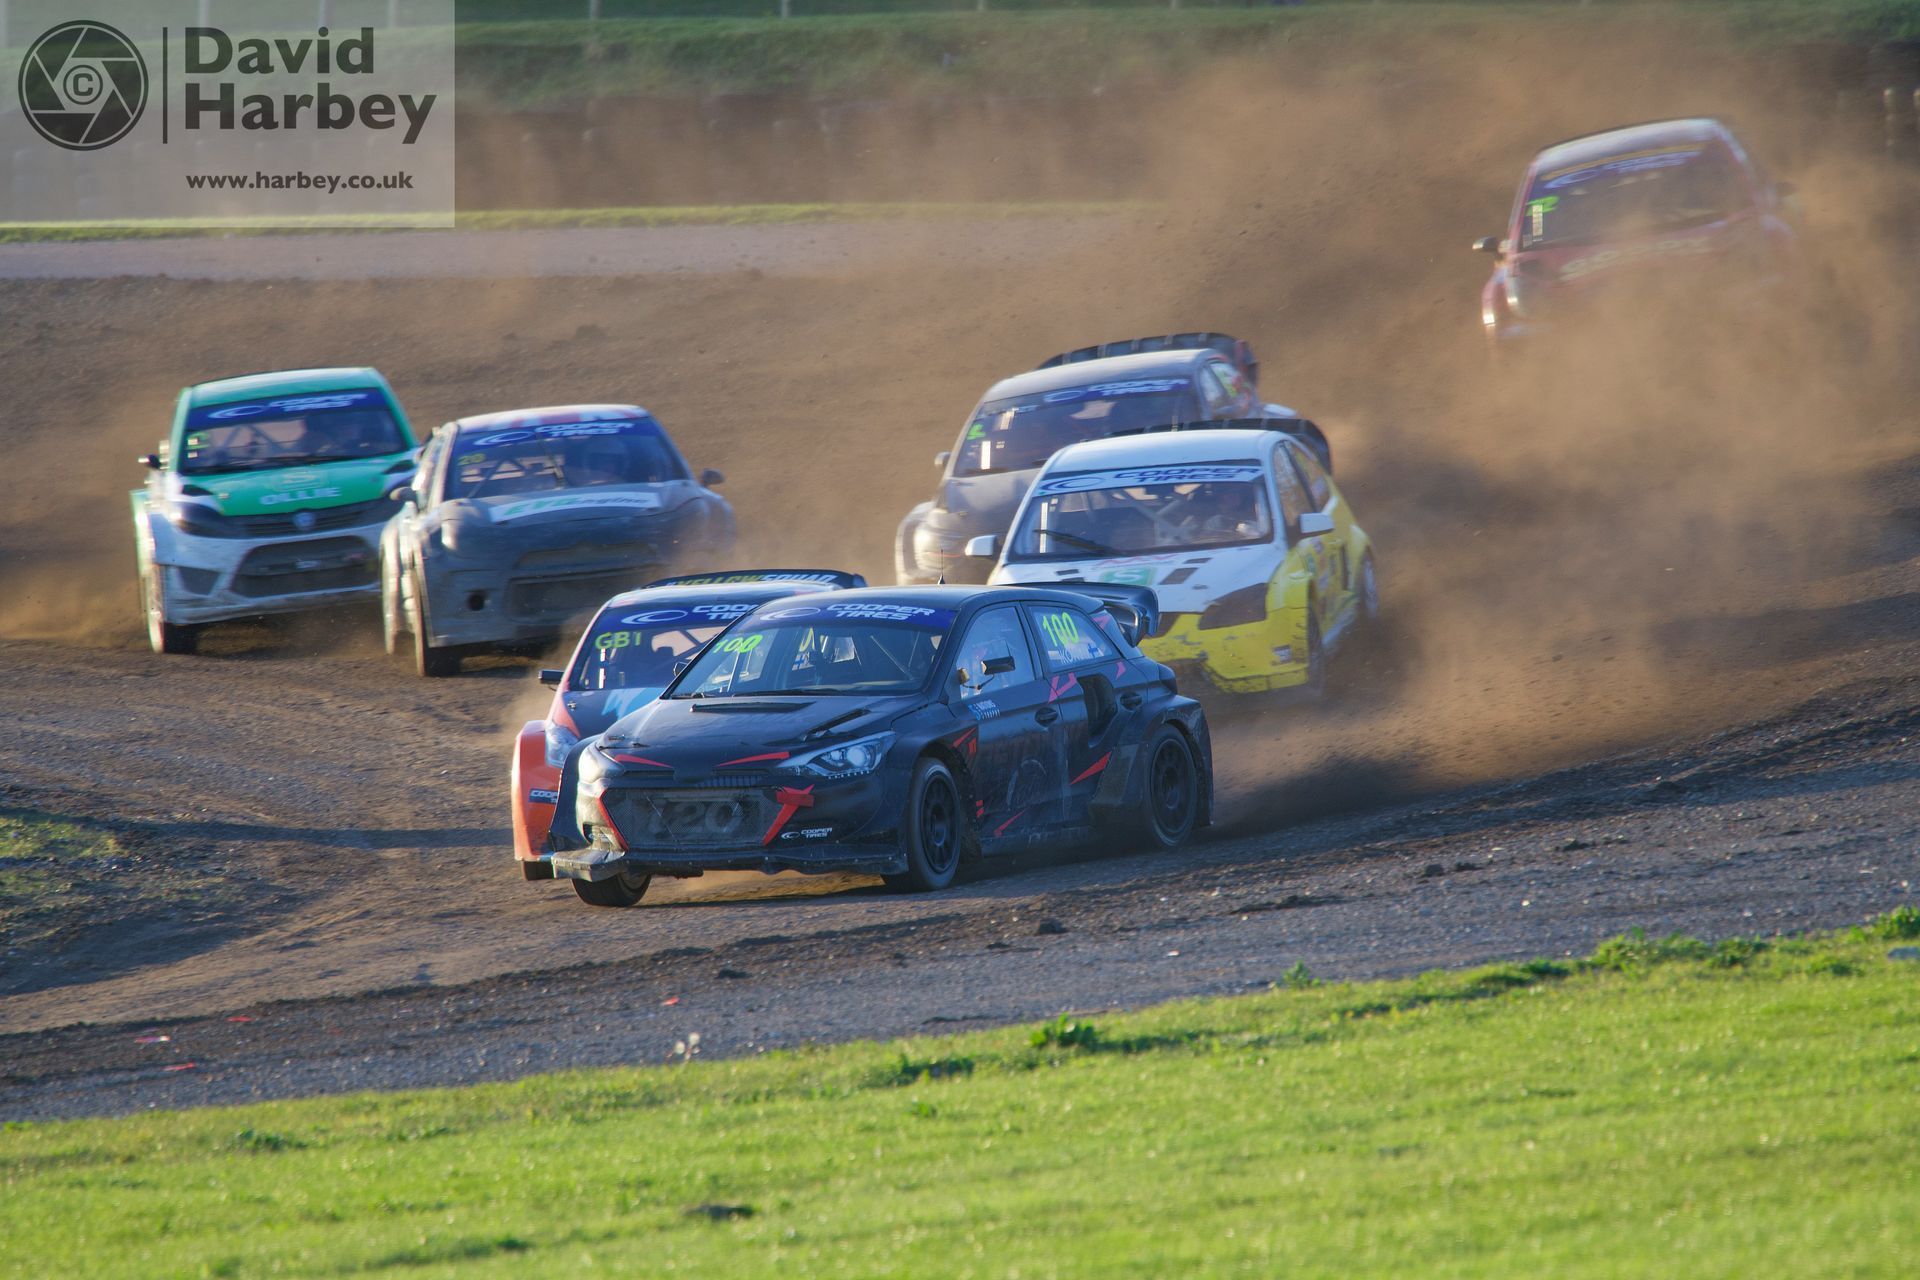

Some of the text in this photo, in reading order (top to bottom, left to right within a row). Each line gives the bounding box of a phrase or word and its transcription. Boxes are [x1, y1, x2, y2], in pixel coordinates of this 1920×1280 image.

[1114, 467, 1260, 480] COOPER
[1136, 474, 1237, 483] TIRES
[692, 604, 759, 613] COO
[826, 603, 936, 616] COOPER
[706, 612, 745, 620] TIR
[836, 610, 912, 621] TIRES
[1042, 612, 1080, 648] 100
[711, 634, 764, 654] 100
[530, 790, 559, 798] COOP
[800, 827, 833, 835] COOPER
